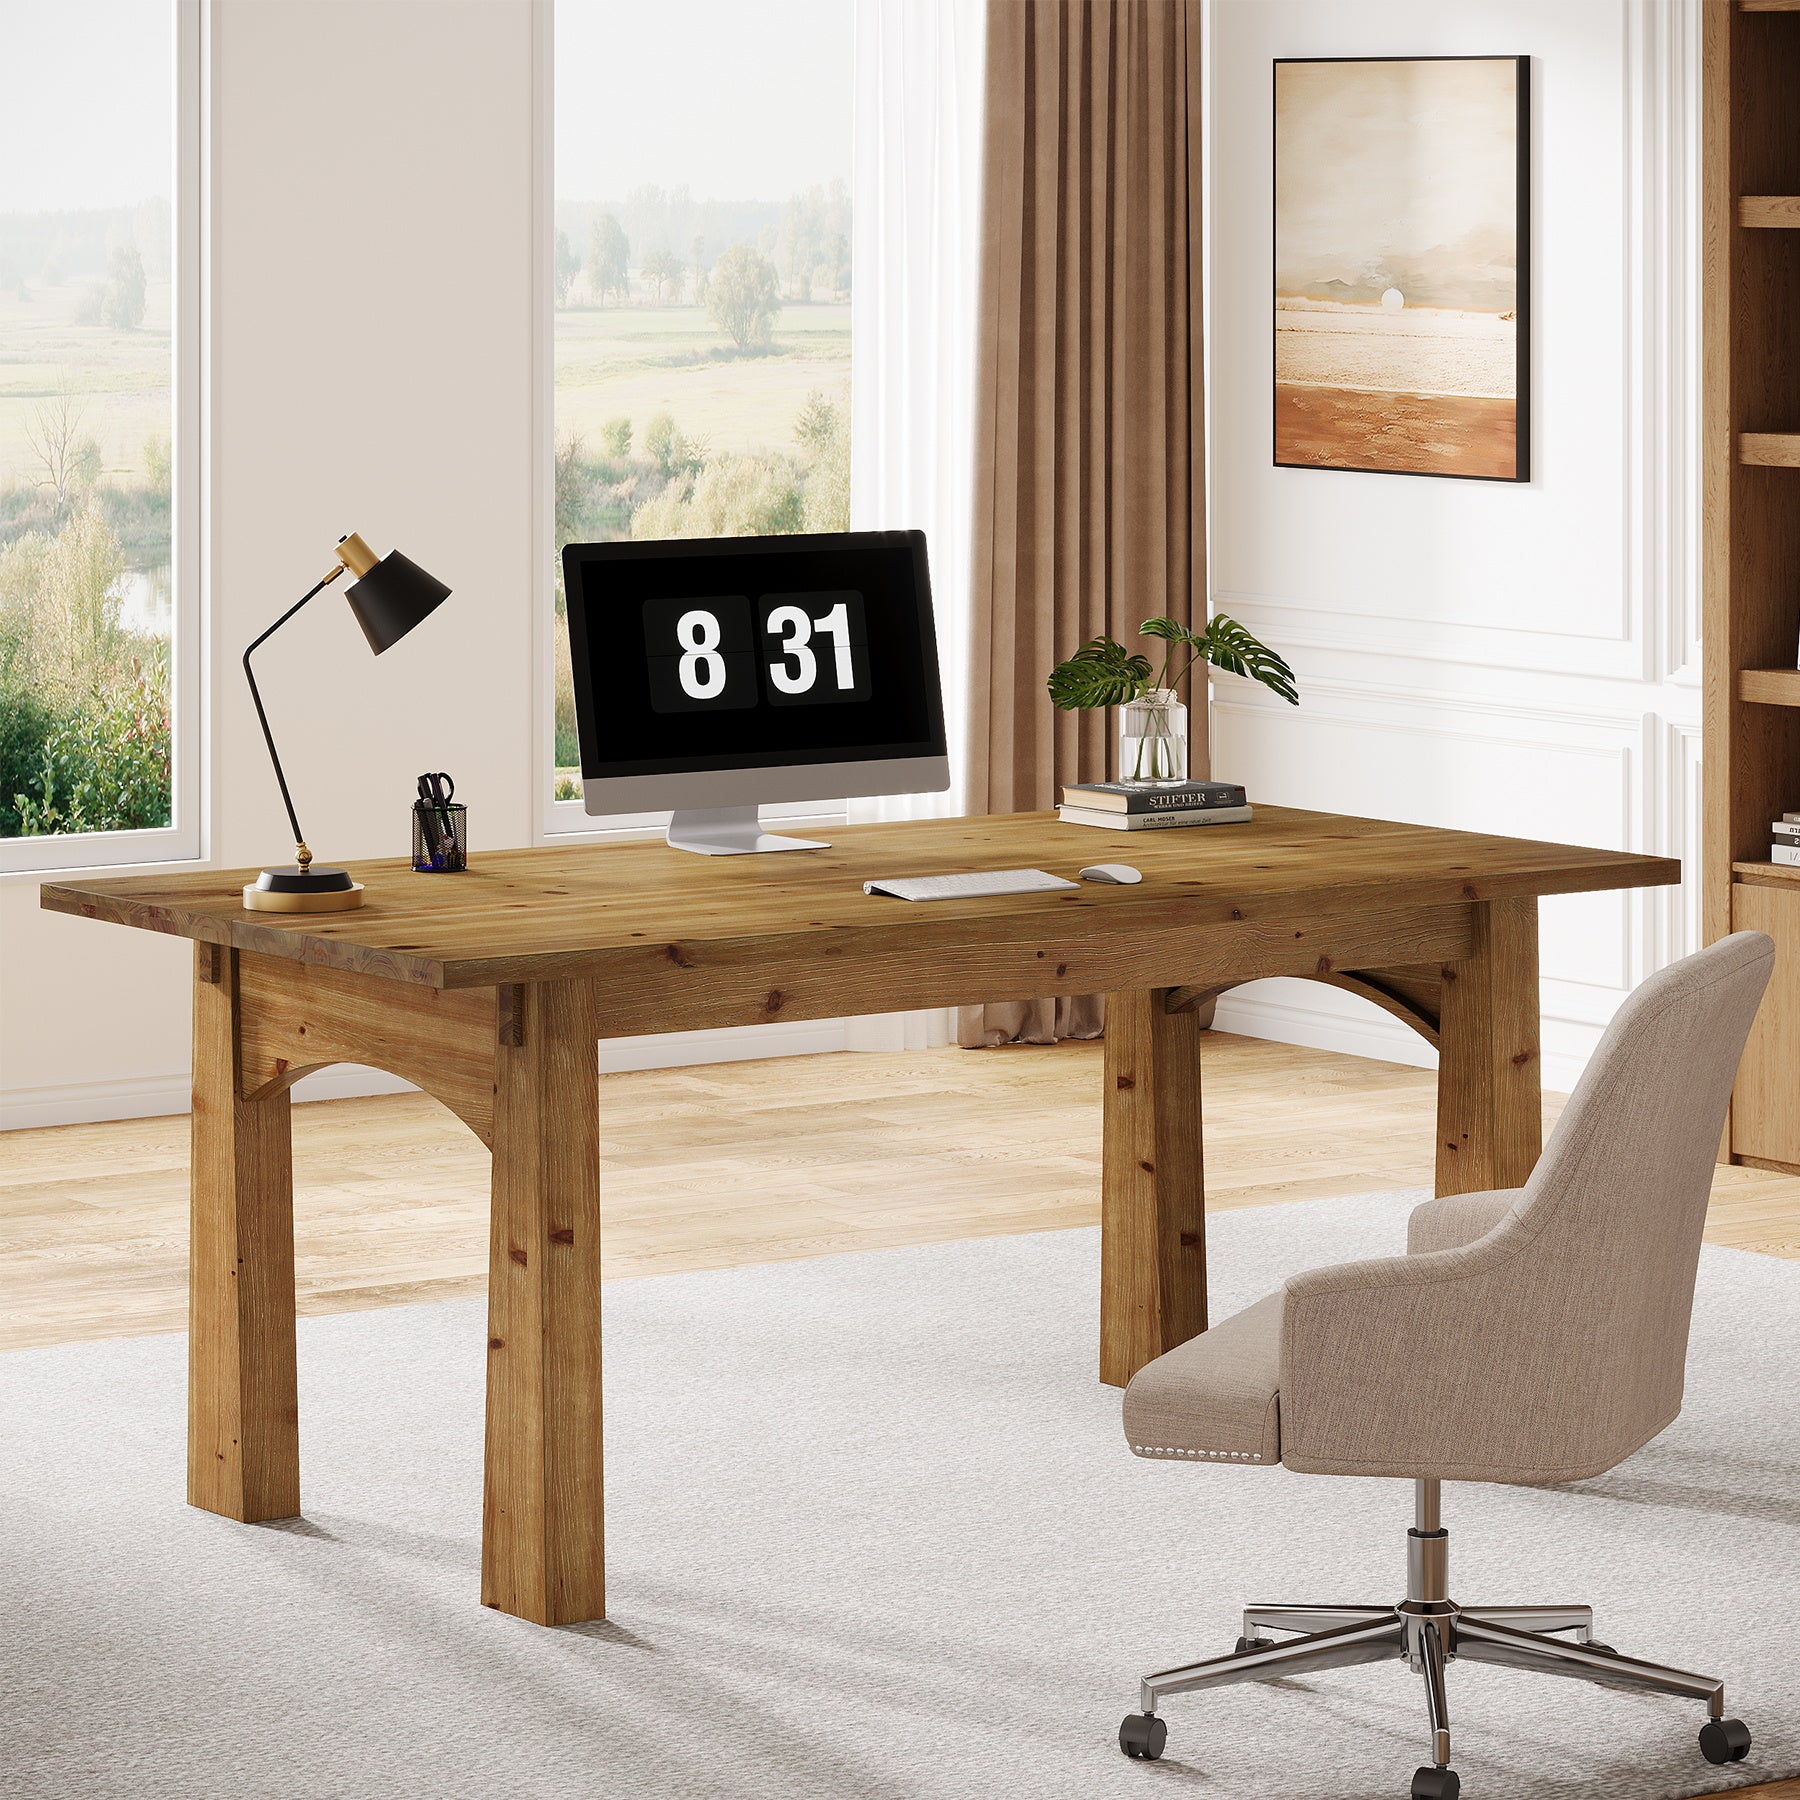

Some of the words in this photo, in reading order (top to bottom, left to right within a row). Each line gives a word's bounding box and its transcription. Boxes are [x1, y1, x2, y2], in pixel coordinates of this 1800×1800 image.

[677, 610, 727, 699] 8
[767, 603, 855, 694] 31
[1149, 793, 1206, 806] STIFTER
